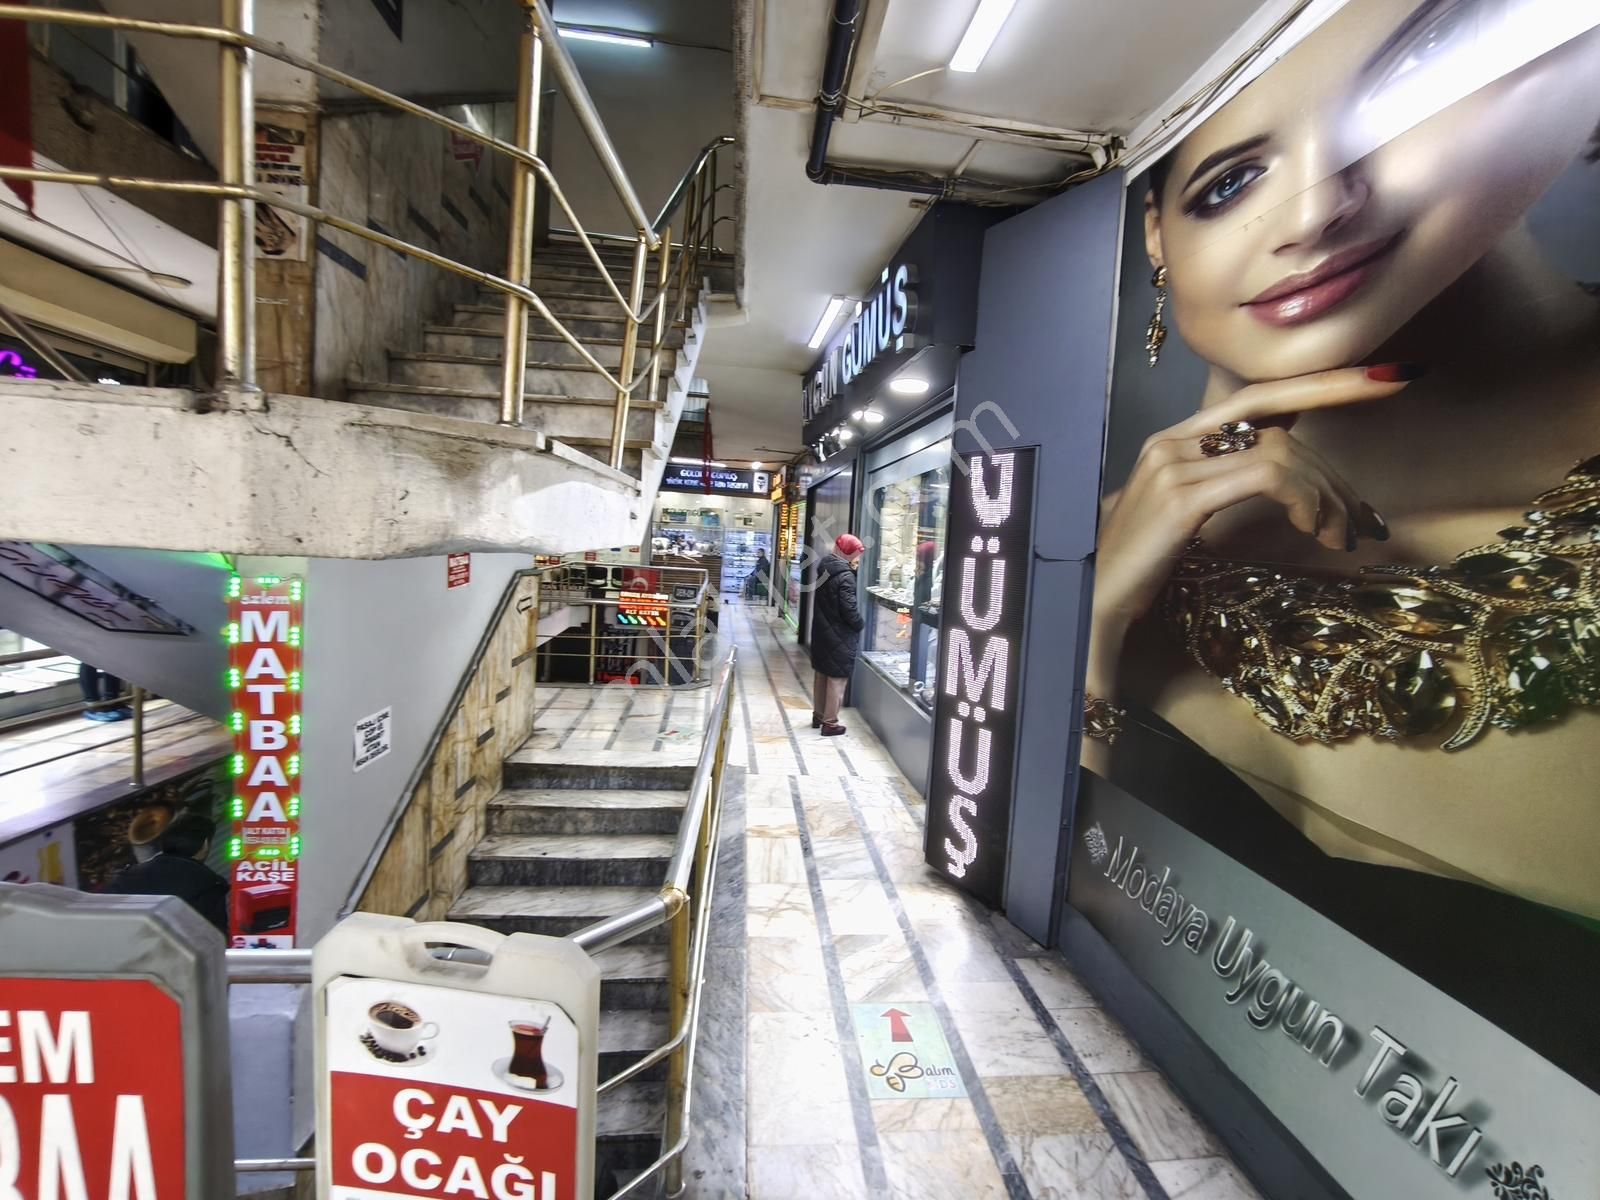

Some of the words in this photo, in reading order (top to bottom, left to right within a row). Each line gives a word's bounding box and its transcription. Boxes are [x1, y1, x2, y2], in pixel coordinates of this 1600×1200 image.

[842, 264, 909, 384] GÜMÜŞ
[241, 610, 290, 822] MATBAA
[236, 871, 296, 883] KAŞE
[237, 859, 295, 871] ACİL
[1104, 836, 1209, 954] Modaya
[1211, 916, 1348, 1068] Uygun
[1354, 1025, 1482, 1178] Takı
[392, 1088, 524, 1143] ÇAY
[352, 1142, 557, 1200] OCAĞI
